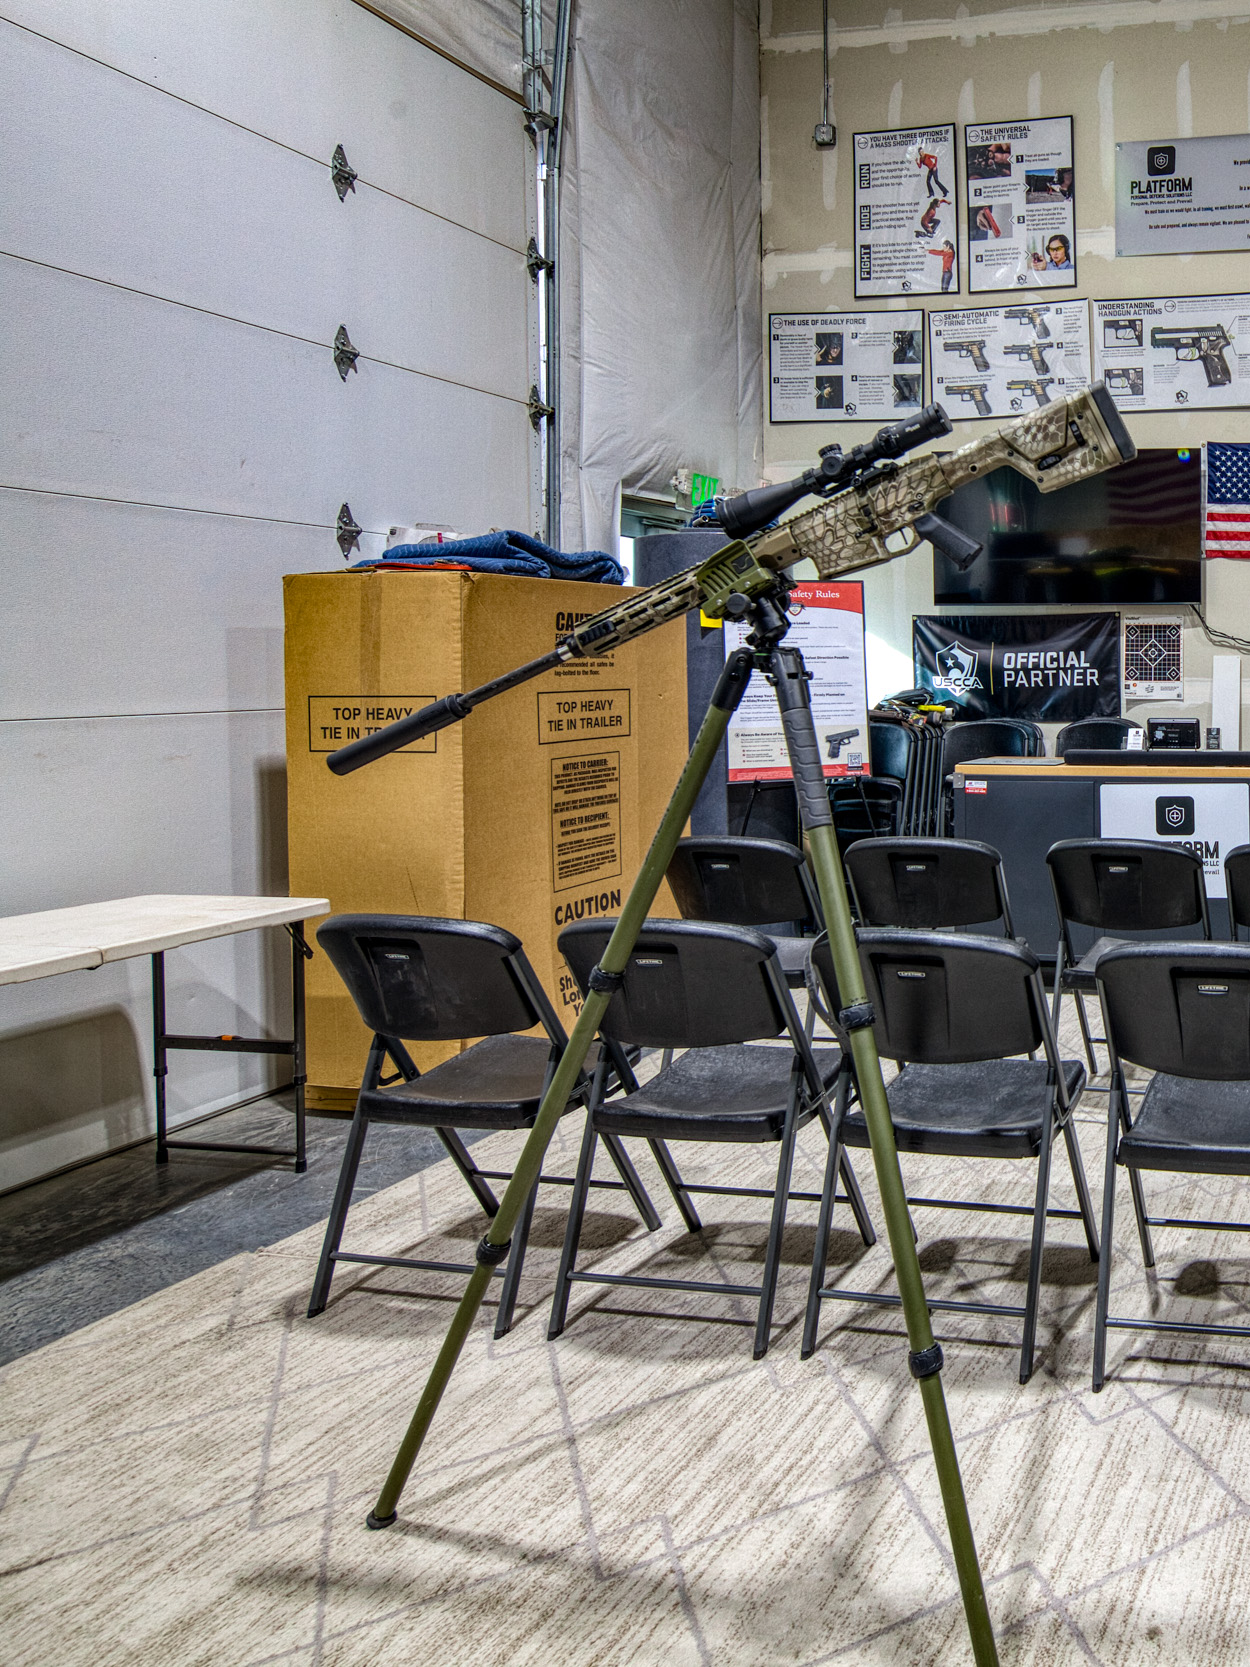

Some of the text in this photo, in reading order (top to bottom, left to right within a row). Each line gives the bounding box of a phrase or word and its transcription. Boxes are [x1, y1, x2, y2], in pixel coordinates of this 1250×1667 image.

[899, 132, 917, 140] THREE
[919, 130, 943, 138] OPTIONS
[995, 126, 1031, 134] UNIVERSAL
[860, 166, 870, 187] RUN
[1131, 177, 1192, 194] PLATFORM
[860, 206, 870, 229] HIDE
[861, 247, 870, 278] FIGHT
[1098, 302, 1154, 310] UNDERSTANDING
[944, 310, 999, 320] SEMI-AUTOMATIC
[1099, 309, 1131, 317] HANDGUN
[944, 319, 965, 327] FIRING
[788, 590, 840, 599] Safety Rules
[1003, 651, 1090, 669] OFFICIAL
[932, 676, 983, 689] USCCA
[1004, 669, 1099, 687] PARTNER
[556, 699, 613, 713] TOP HEAVY
[333, 708, 413, 720] TOP HEAVY
[548, 715, 622, 732] TIE IN TRAILER
[321, 727, 359, 739] TIE IN
[562, 761, 580, 771] NOTICE
[580, 761, 586, 769] TO
[560, 812, 610, 828] NOTICE TO RECIPIENT:
[555, 889, 621, 925] CAUTION
